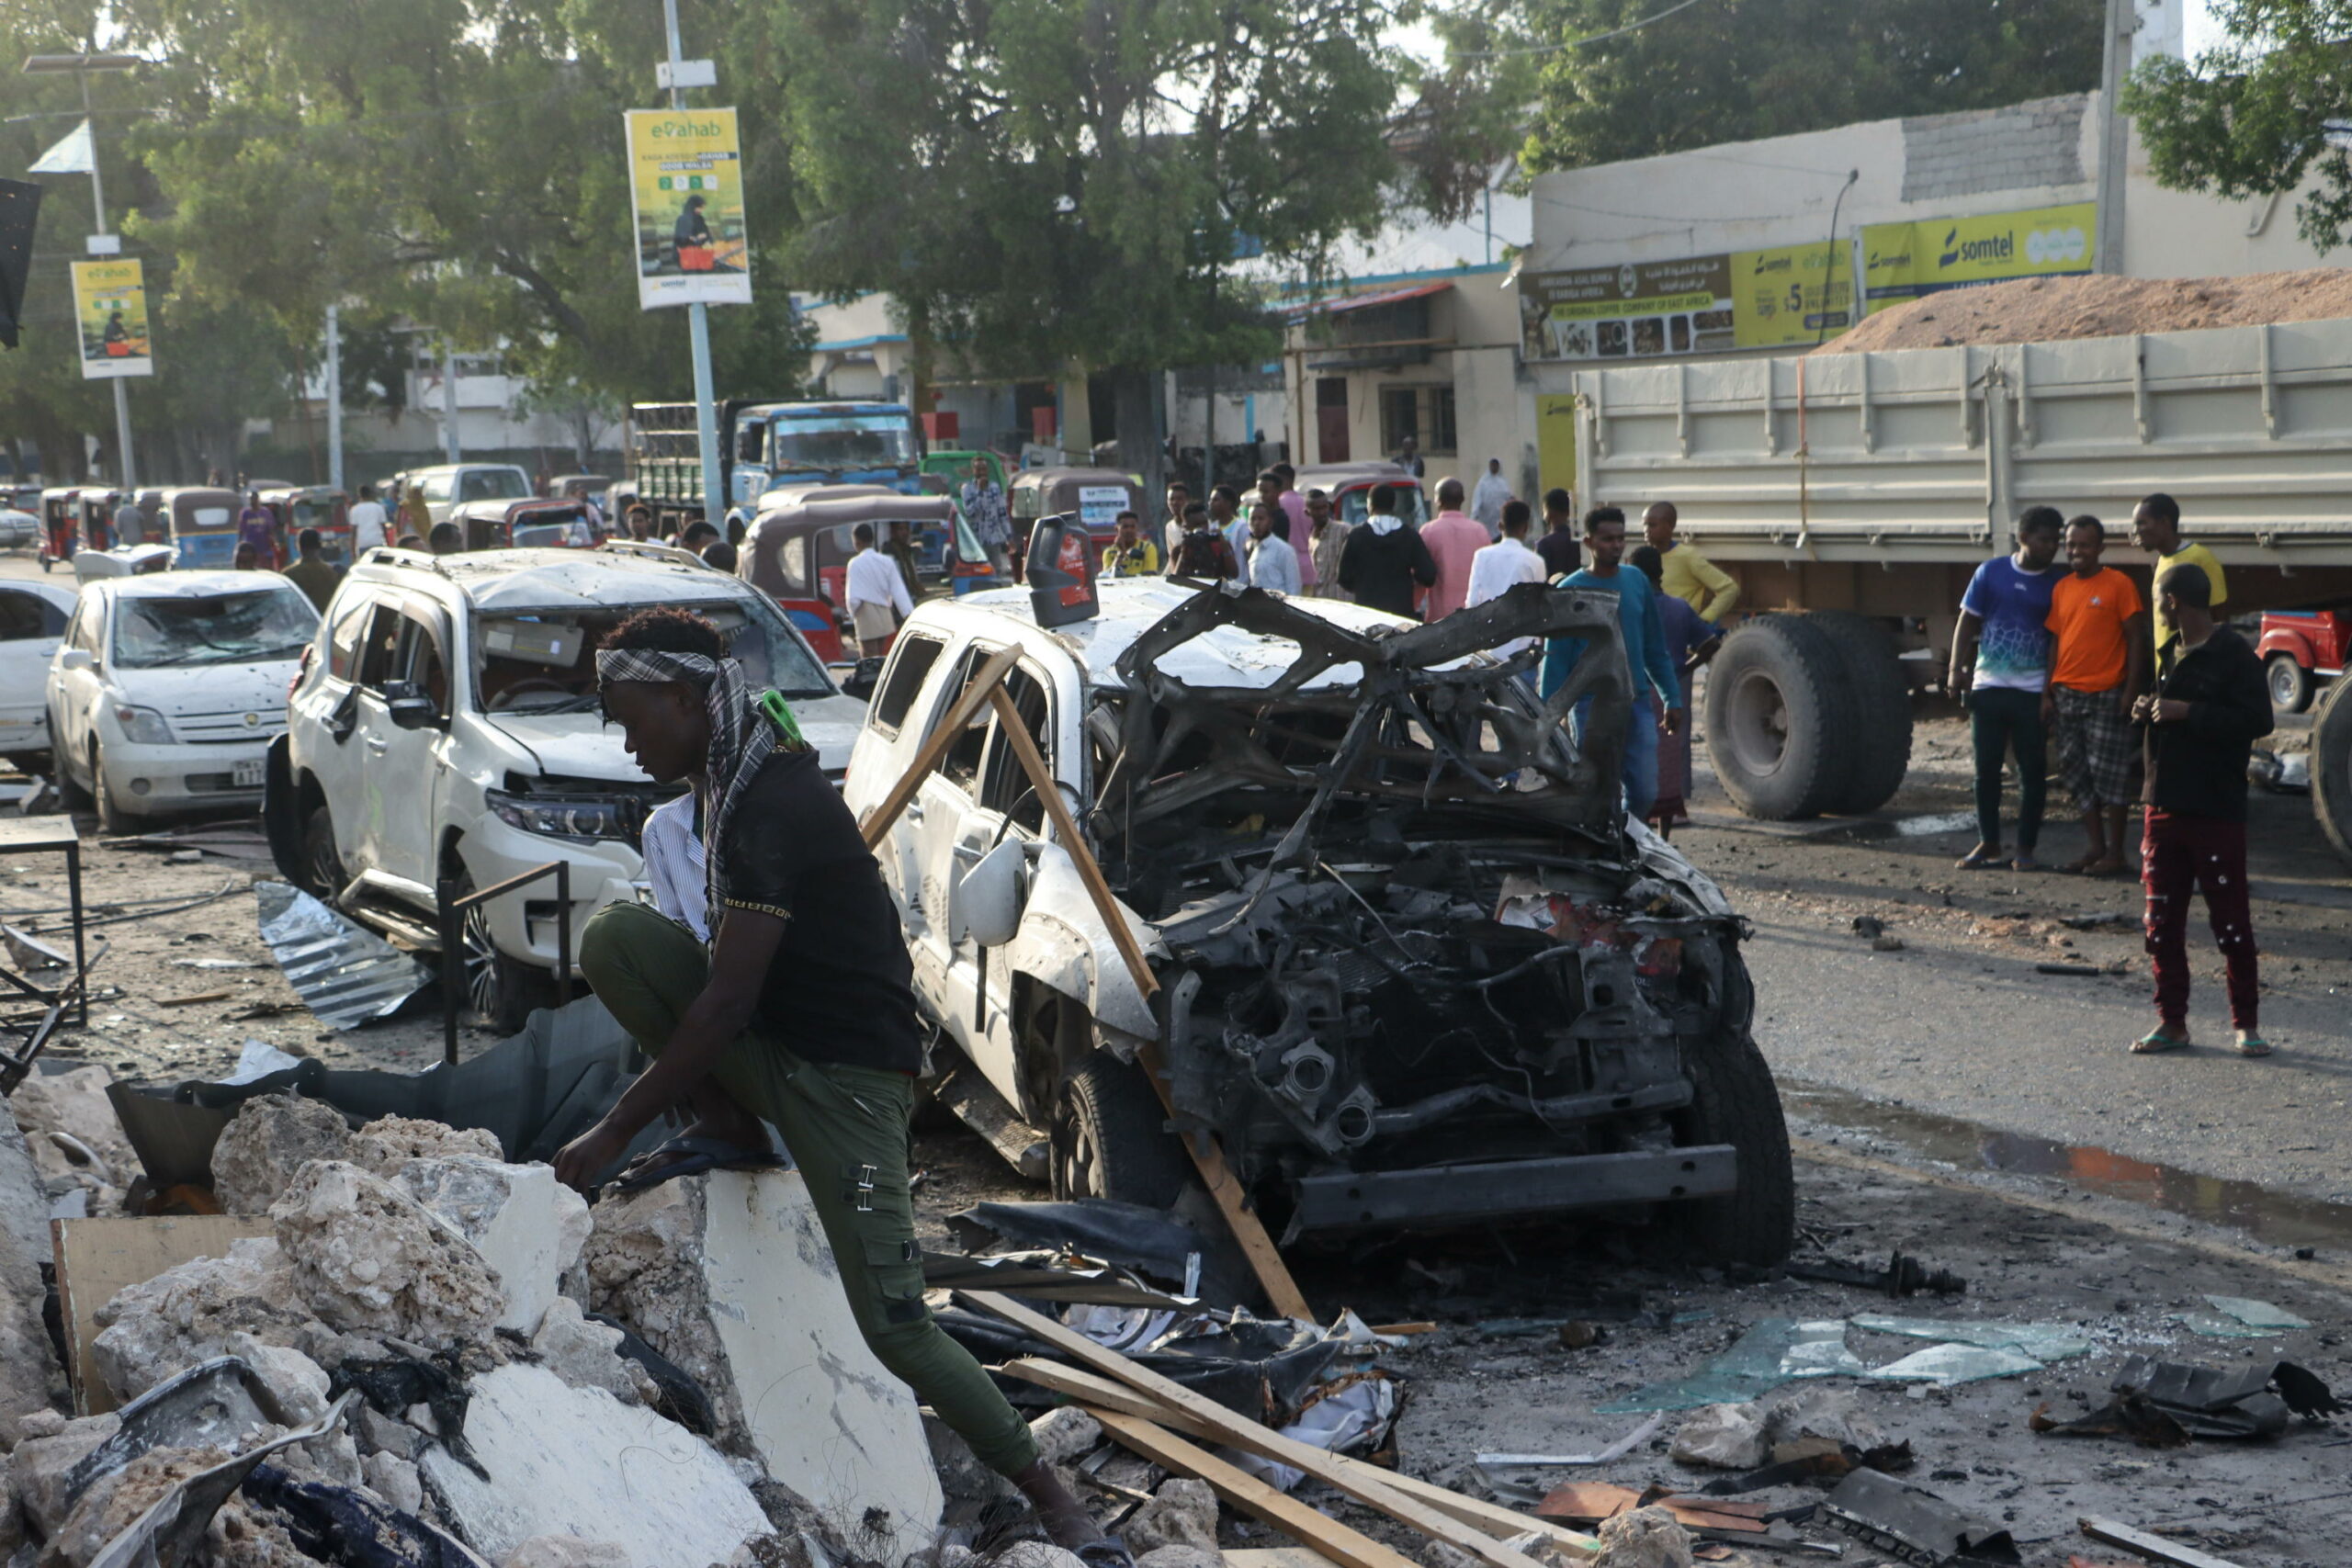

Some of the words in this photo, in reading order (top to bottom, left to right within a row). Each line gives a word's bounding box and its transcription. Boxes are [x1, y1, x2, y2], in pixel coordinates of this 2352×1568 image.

[1961, 231, 2014, 261] somtel
[1623, 301, 1657, 313] COMPANY
[1657, 299, 1666, 310] OF
[1668, 299, 1684, 310] EAST
[1685, 295, 1710, 307] AFRICA
